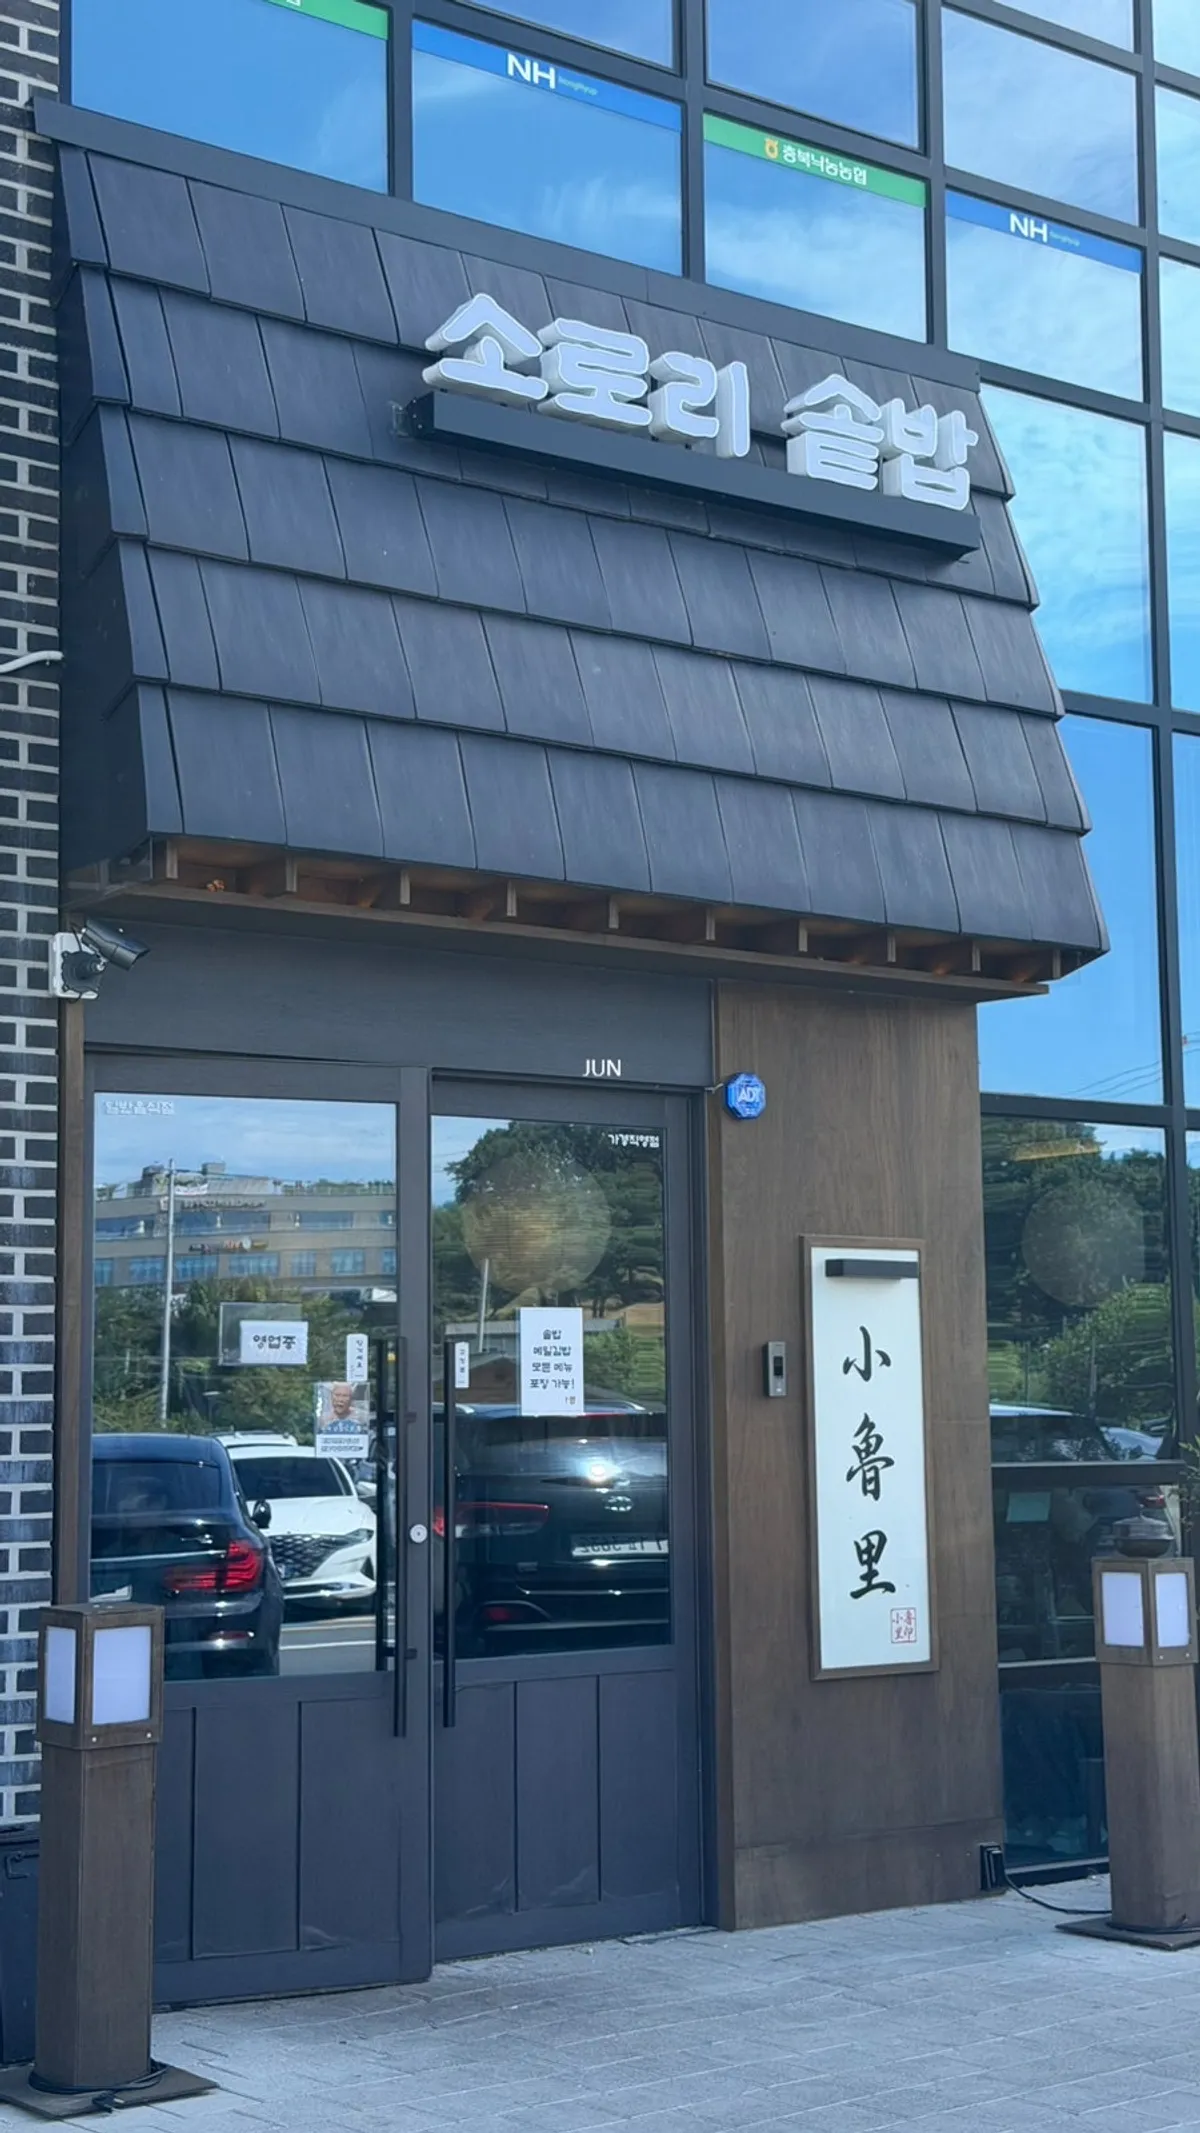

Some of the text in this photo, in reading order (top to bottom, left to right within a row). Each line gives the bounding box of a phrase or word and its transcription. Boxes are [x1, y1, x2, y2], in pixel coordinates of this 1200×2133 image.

[508, 53, 556, 90] NH
[1010, 212, 1048, 243] NH
[422, 293, 979, 511] 소로리 솥밥
[582, 1058, 622, 1077] JUN
[253, 1334, 296, 1350] 영업중
[532, 1362, 573, 1373] 모든 메뉴
[530, 1378, 549, 1390] 포장
[842, 1325, 896, 1600] 小魯里
